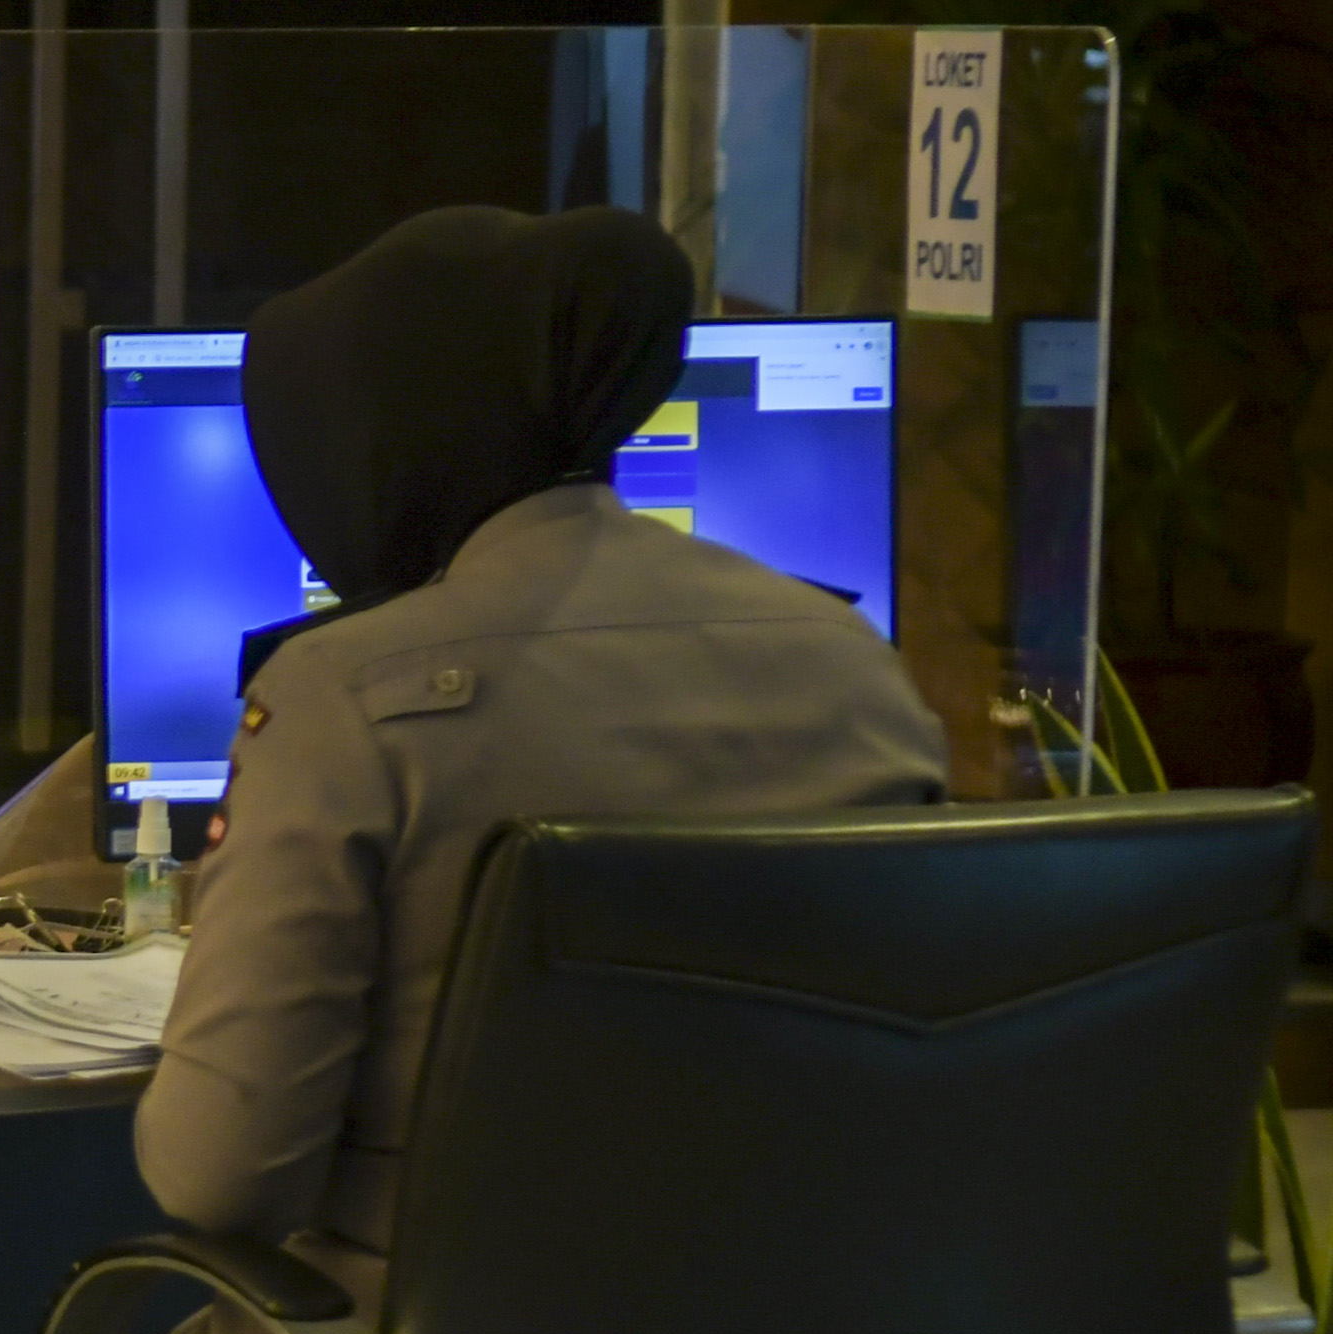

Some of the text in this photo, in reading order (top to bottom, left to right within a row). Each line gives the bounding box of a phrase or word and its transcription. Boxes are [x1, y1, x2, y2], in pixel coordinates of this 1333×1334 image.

[925, 52, 986, 87] LOKET
[921, 107, 981, 220] 12
[916, 241, 983, 282] POLRI
[114, 767, 146, 778] 09:42
